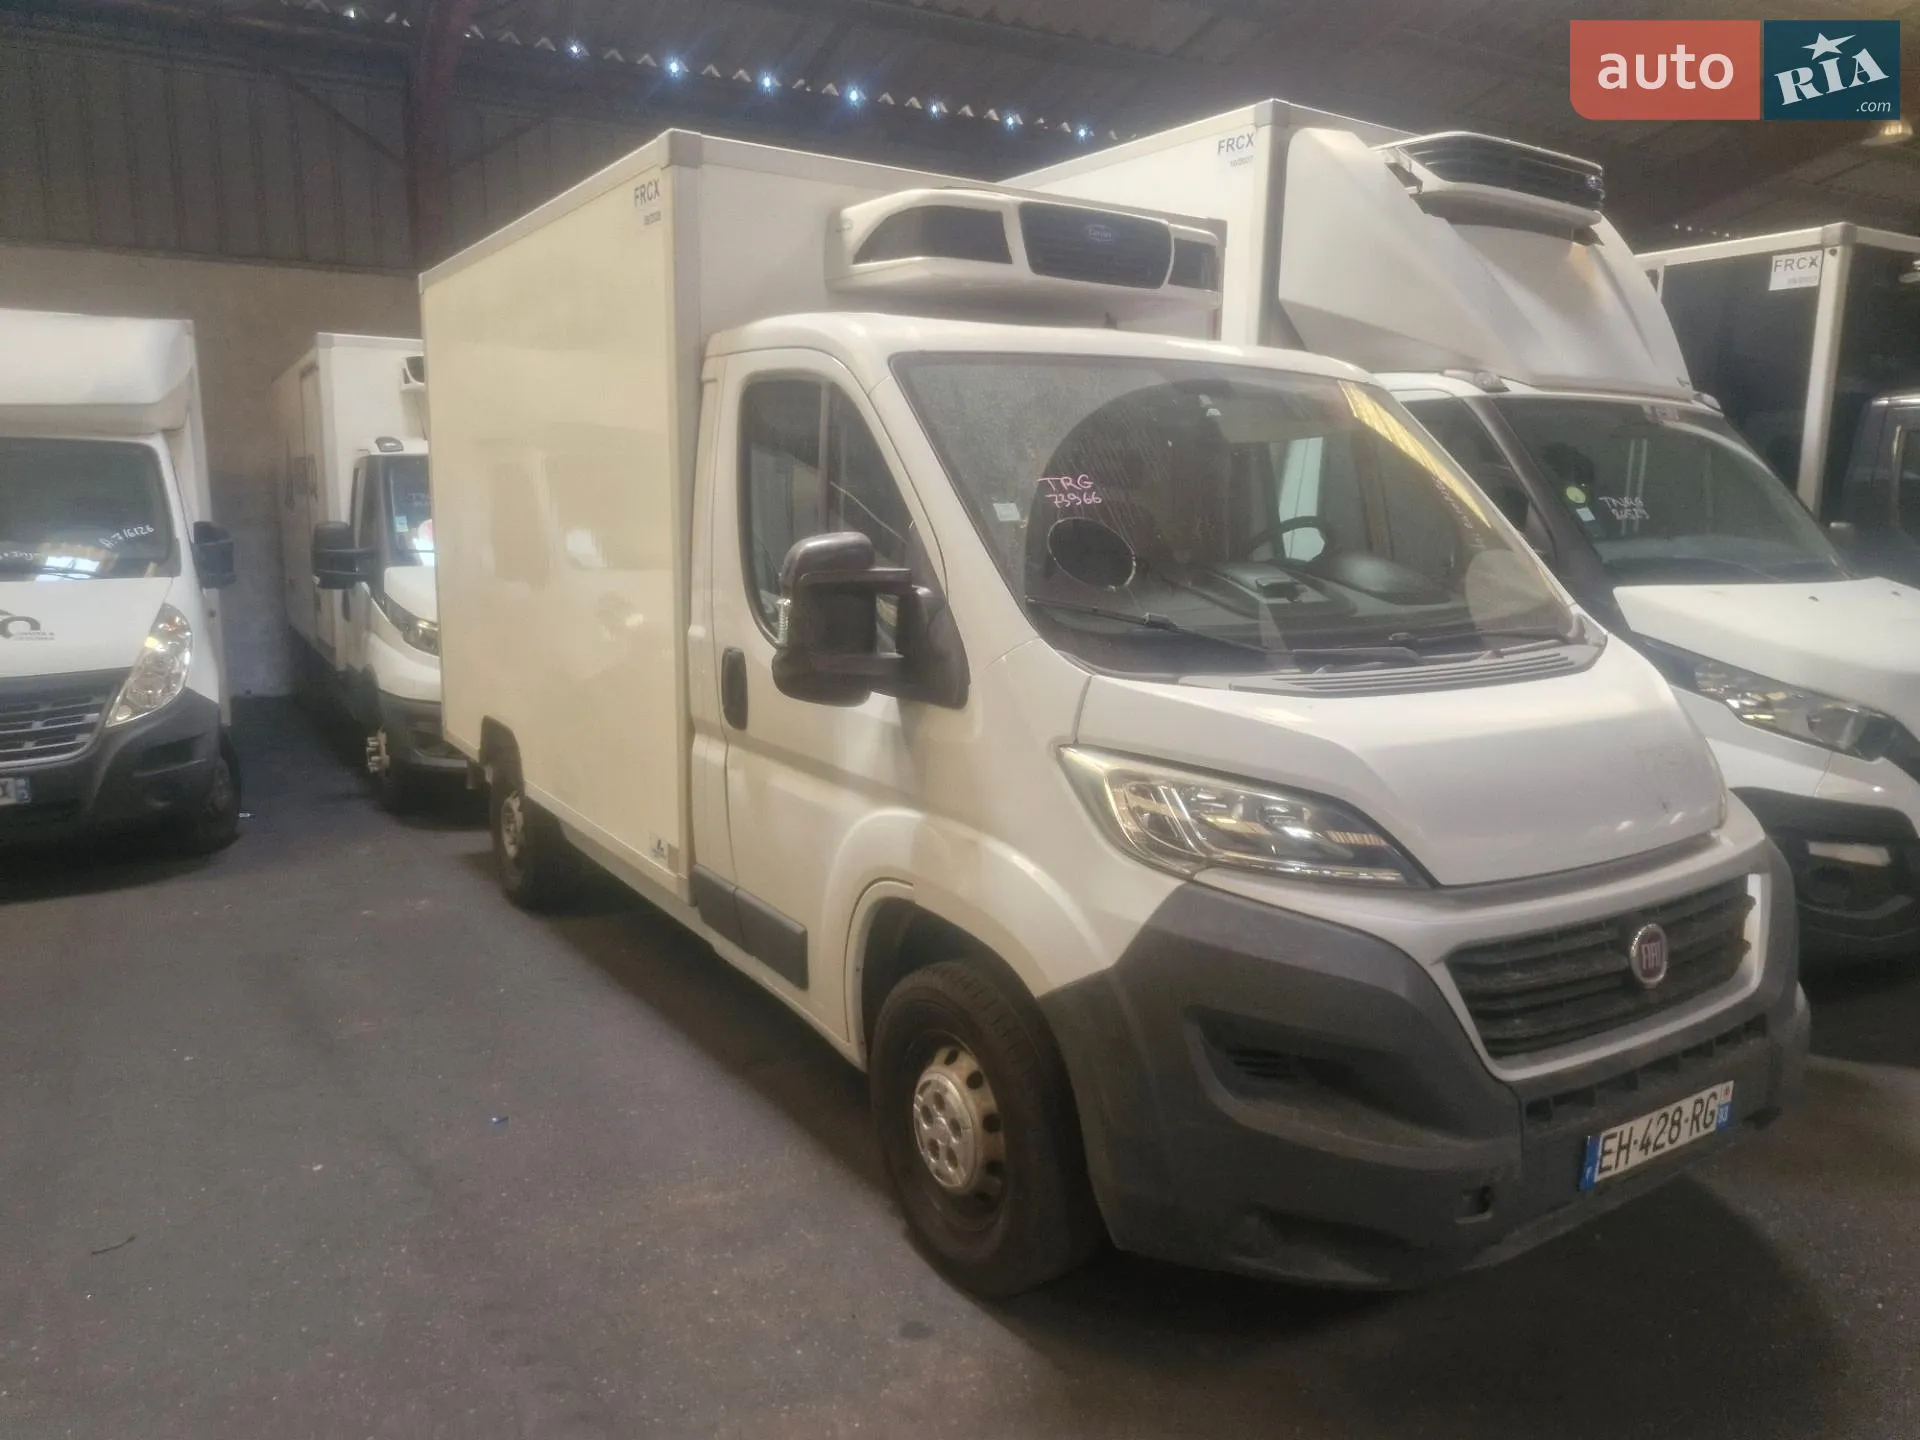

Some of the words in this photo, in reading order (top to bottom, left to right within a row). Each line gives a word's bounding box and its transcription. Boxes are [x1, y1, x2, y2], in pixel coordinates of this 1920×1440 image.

[1217, 131, 1254, 156] FRCX
[634, 177, 661, 208] FRCX
[1773, 255, 1818, 272] FRCX
[1037, 474, 1094, 491] TRG
